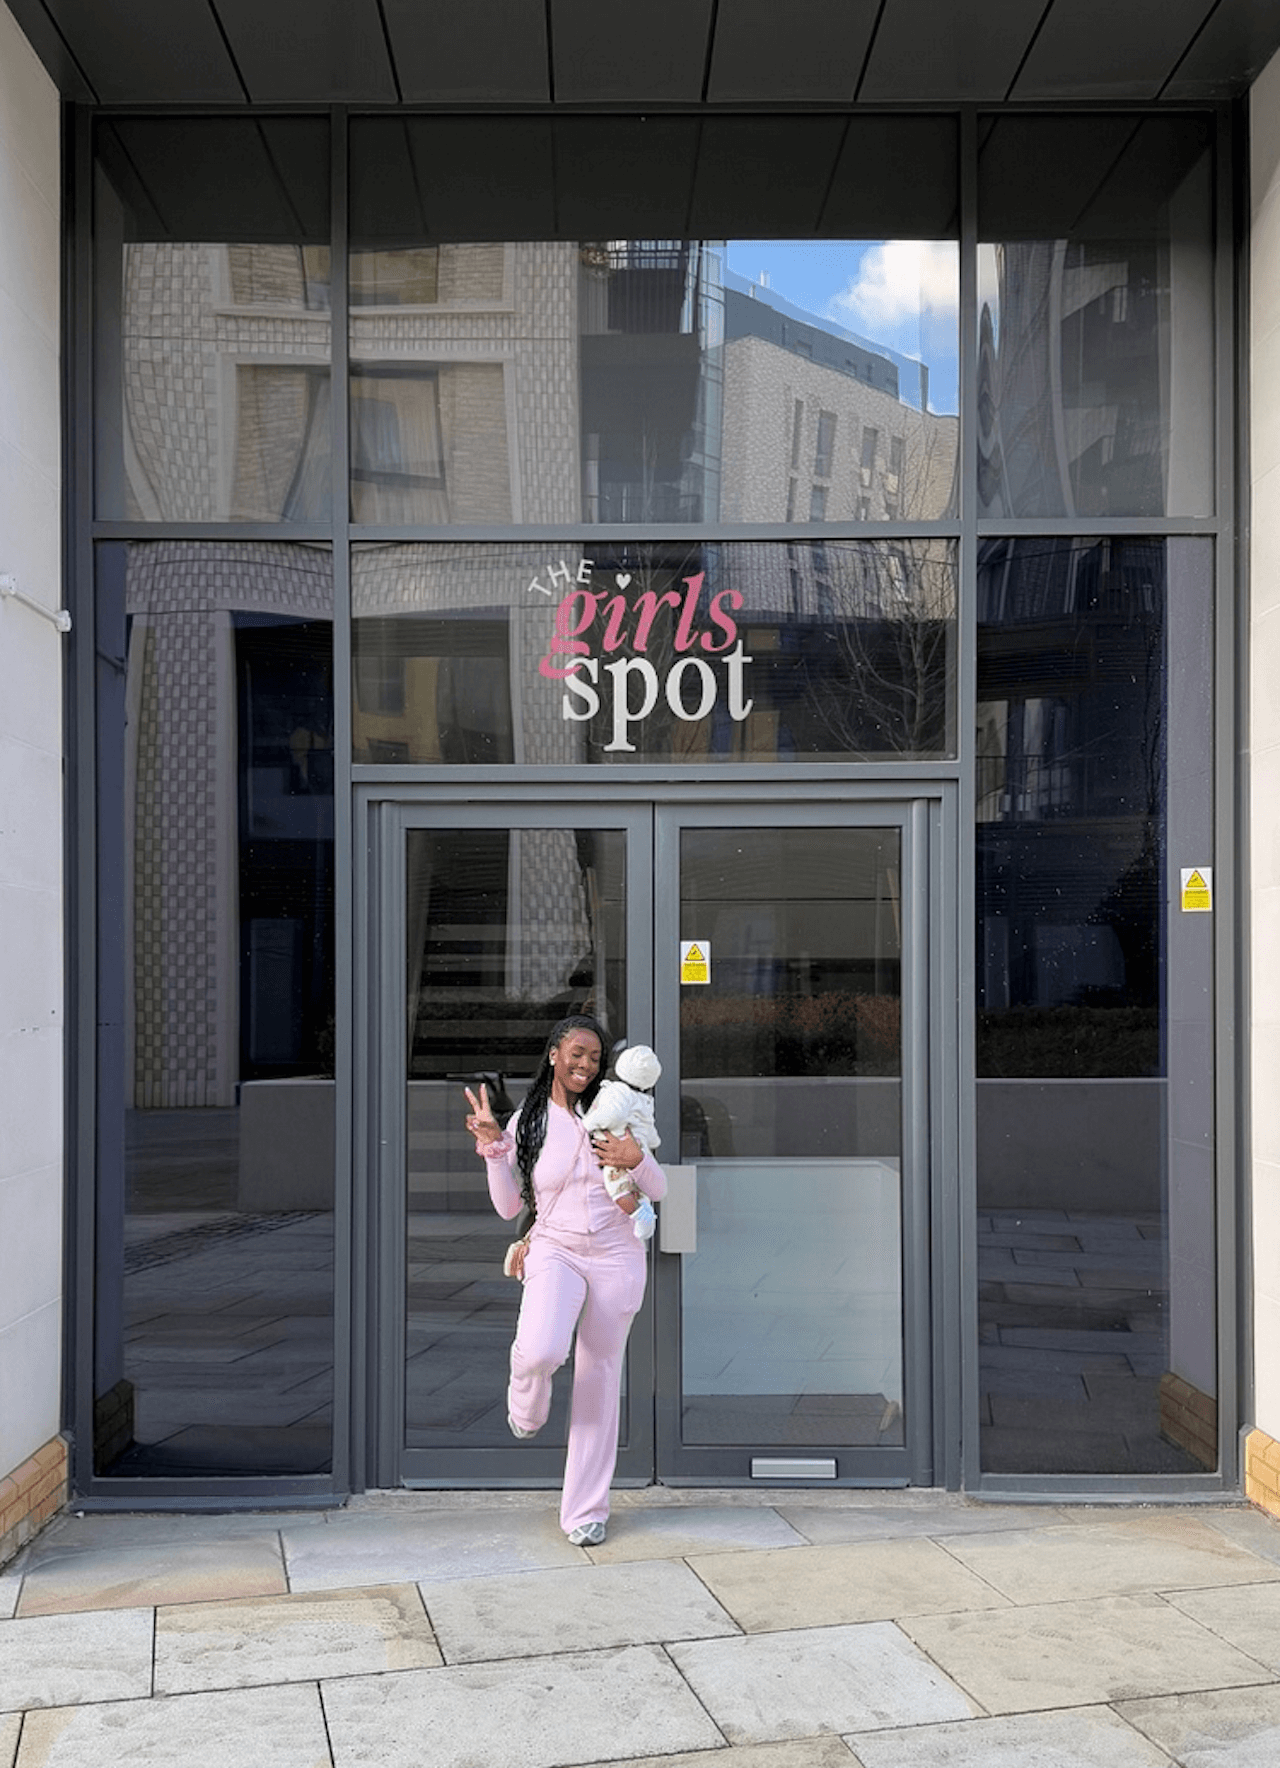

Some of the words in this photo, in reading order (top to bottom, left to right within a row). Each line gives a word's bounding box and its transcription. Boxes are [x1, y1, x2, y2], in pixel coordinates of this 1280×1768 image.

[528, 559, 594, 596] THE
[538, 571, 744, 679] girls
[563, 639, 753, 752] spot
